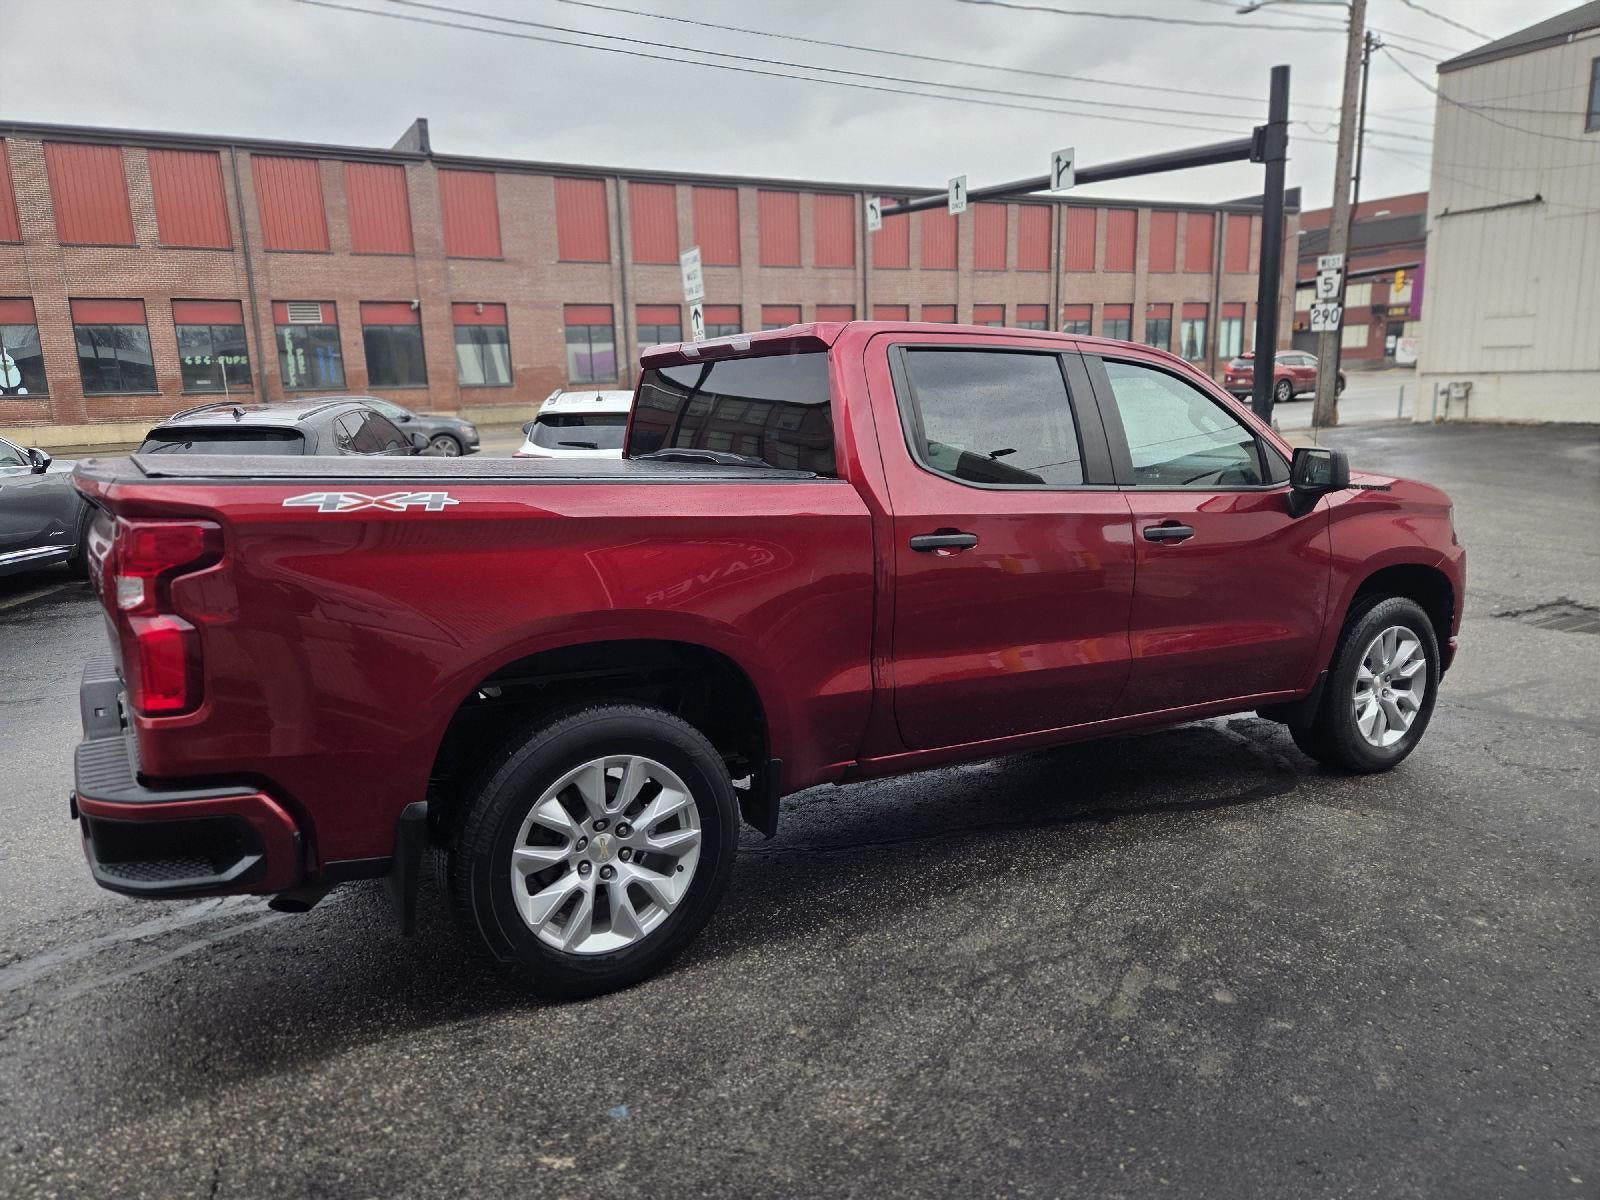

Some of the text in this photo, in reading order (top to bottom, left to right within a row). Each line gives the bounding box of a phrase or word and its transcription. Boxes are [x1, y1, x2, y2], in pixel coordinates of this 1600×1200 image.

[951, 200, 965, 210] ONLY
[1321, 257, 1341, 267] WEST
[1323, 277, 1334, 293] 5
[1312, 308, 1339, 325] 290
[282, 491, 460, 513] 4X4
